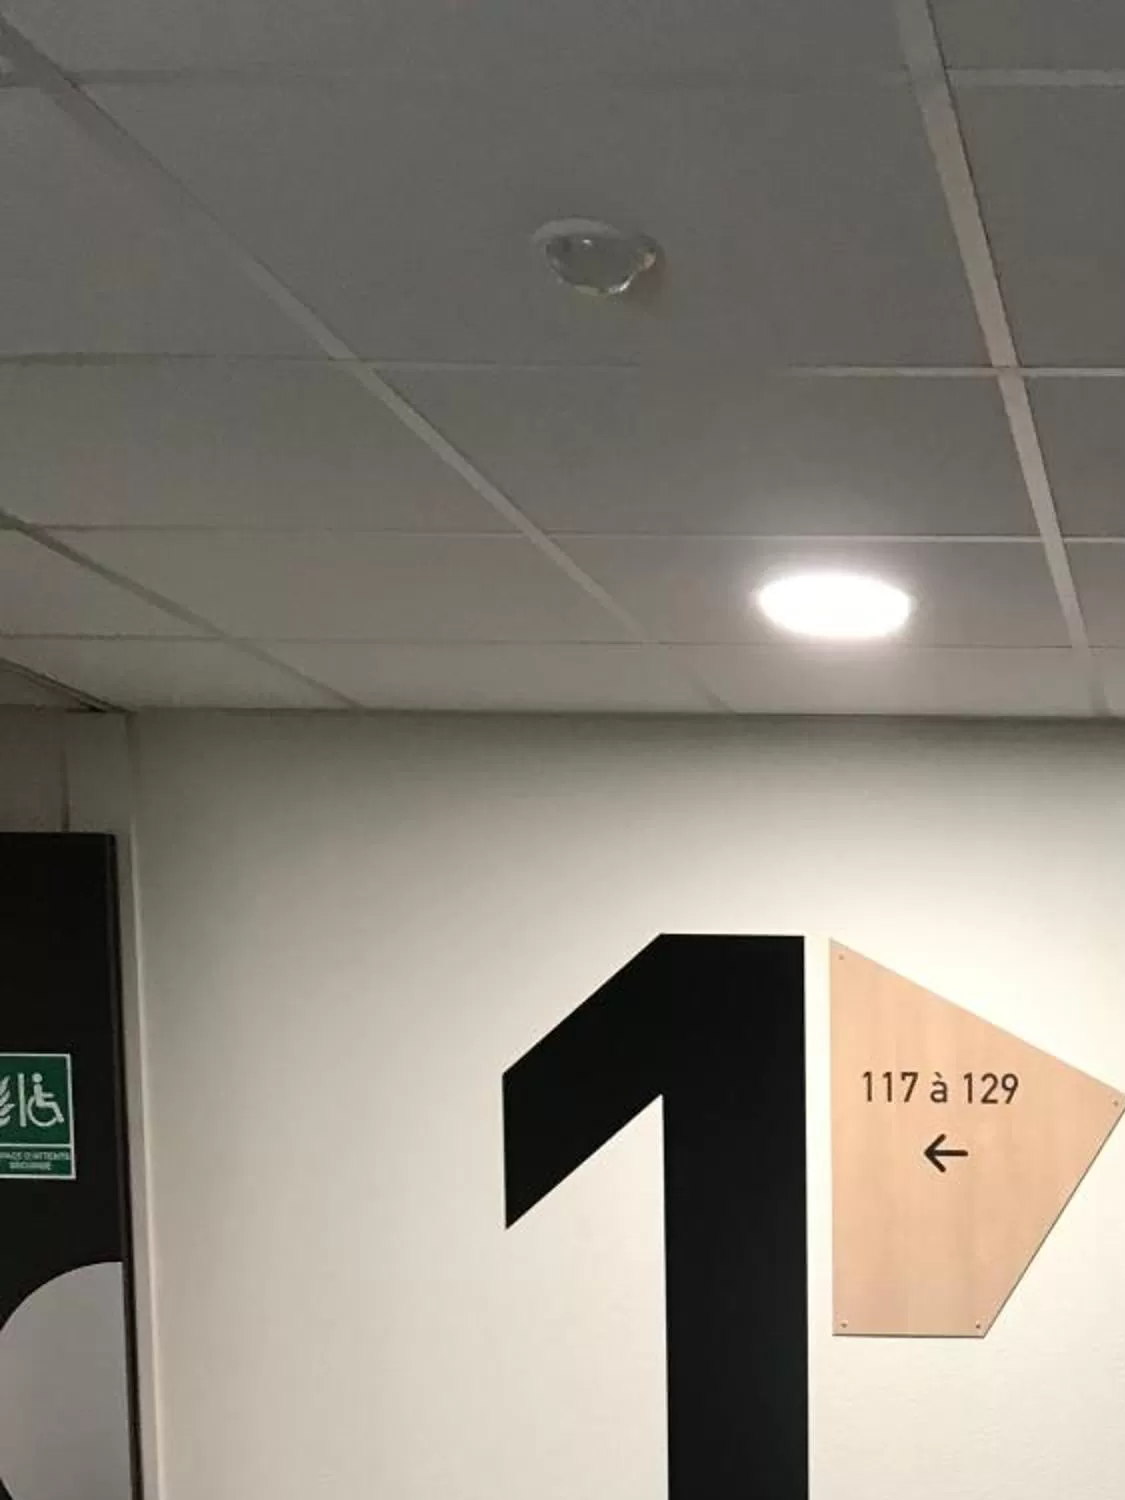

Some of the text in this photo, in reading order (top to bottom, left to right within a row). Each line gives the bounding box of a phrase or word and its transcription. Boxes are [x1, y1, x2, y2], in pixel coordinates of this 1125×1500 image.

[862, 1071, 1019, 1104] 117 à 129
